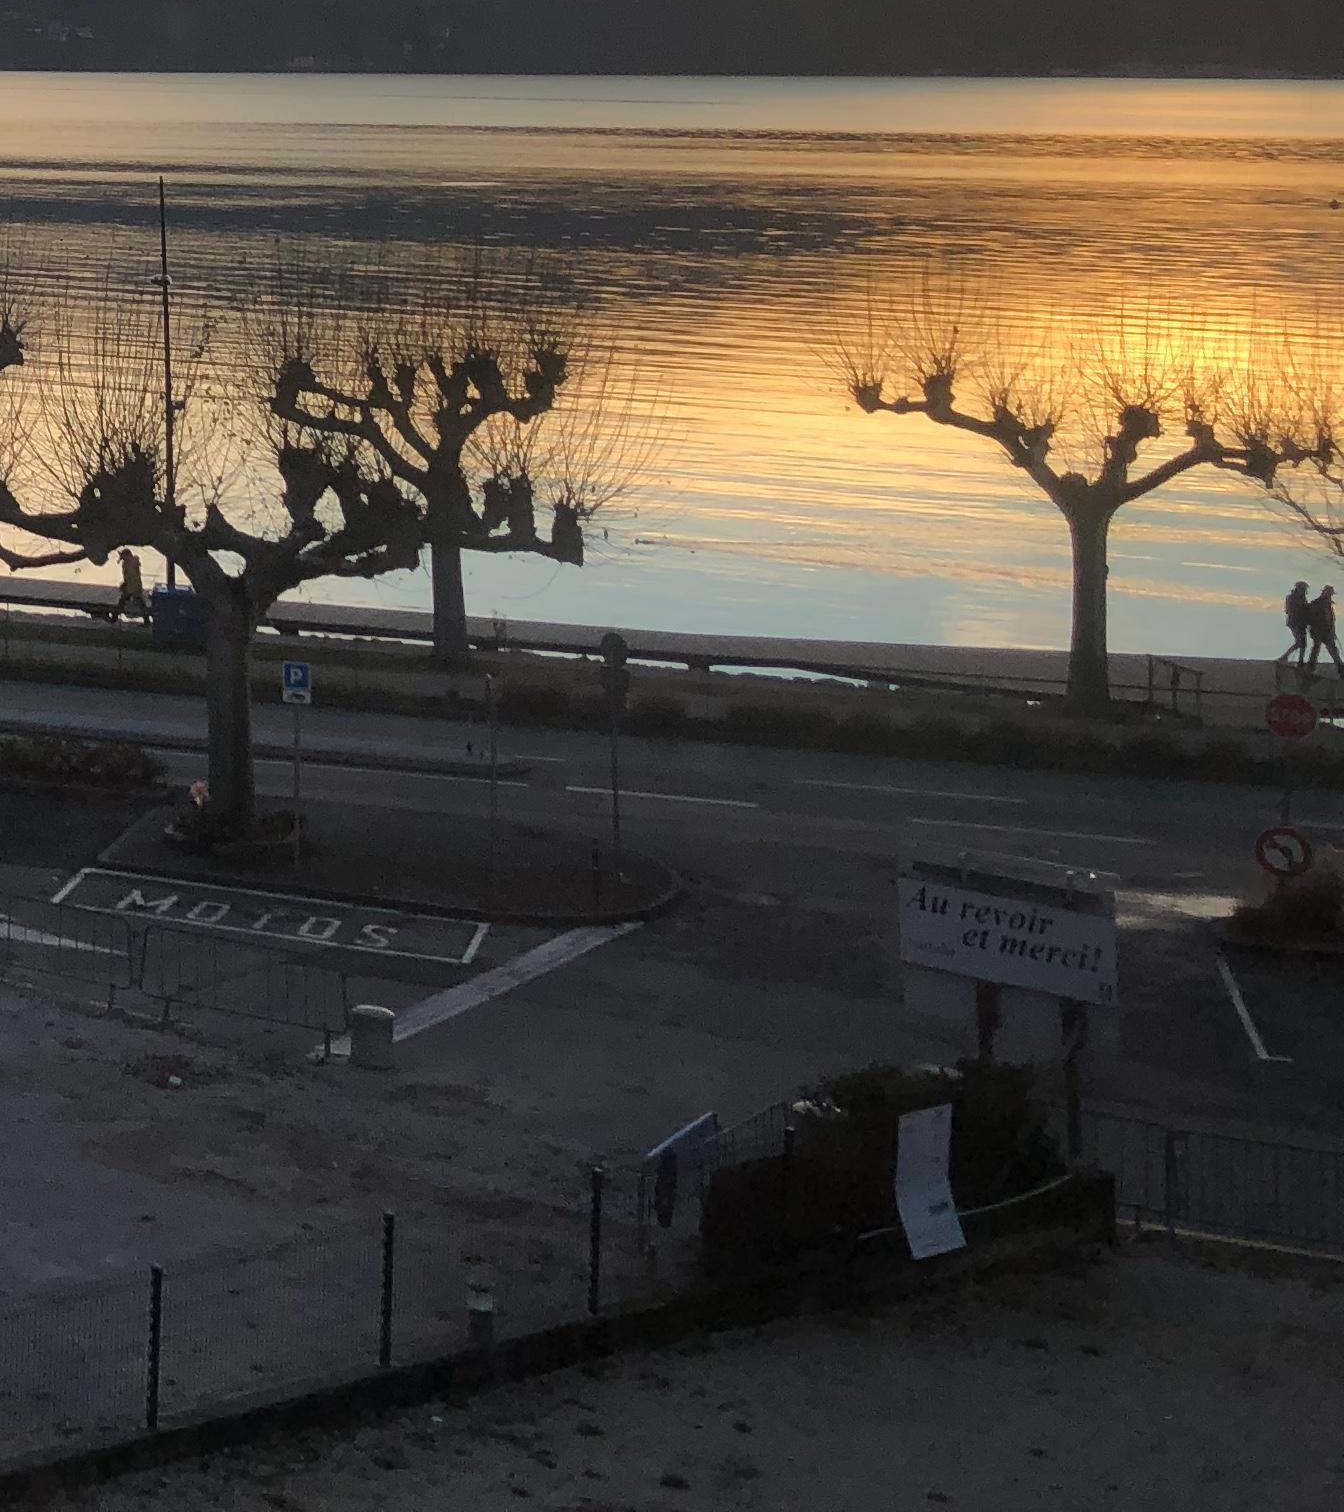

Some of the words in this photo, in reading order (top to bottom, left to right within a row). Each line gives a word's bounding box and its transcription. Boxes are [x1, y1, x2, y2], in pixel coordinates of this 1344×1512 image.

[290, 668, 303, 684] P
[116, 889, 399, 947] MOTOS
[906, 885, 950, 915] Au
[960, 901, 1054, 934] revoir
[961, 928, 991, 950] et
[999, 934, 1104, 973] merci!
